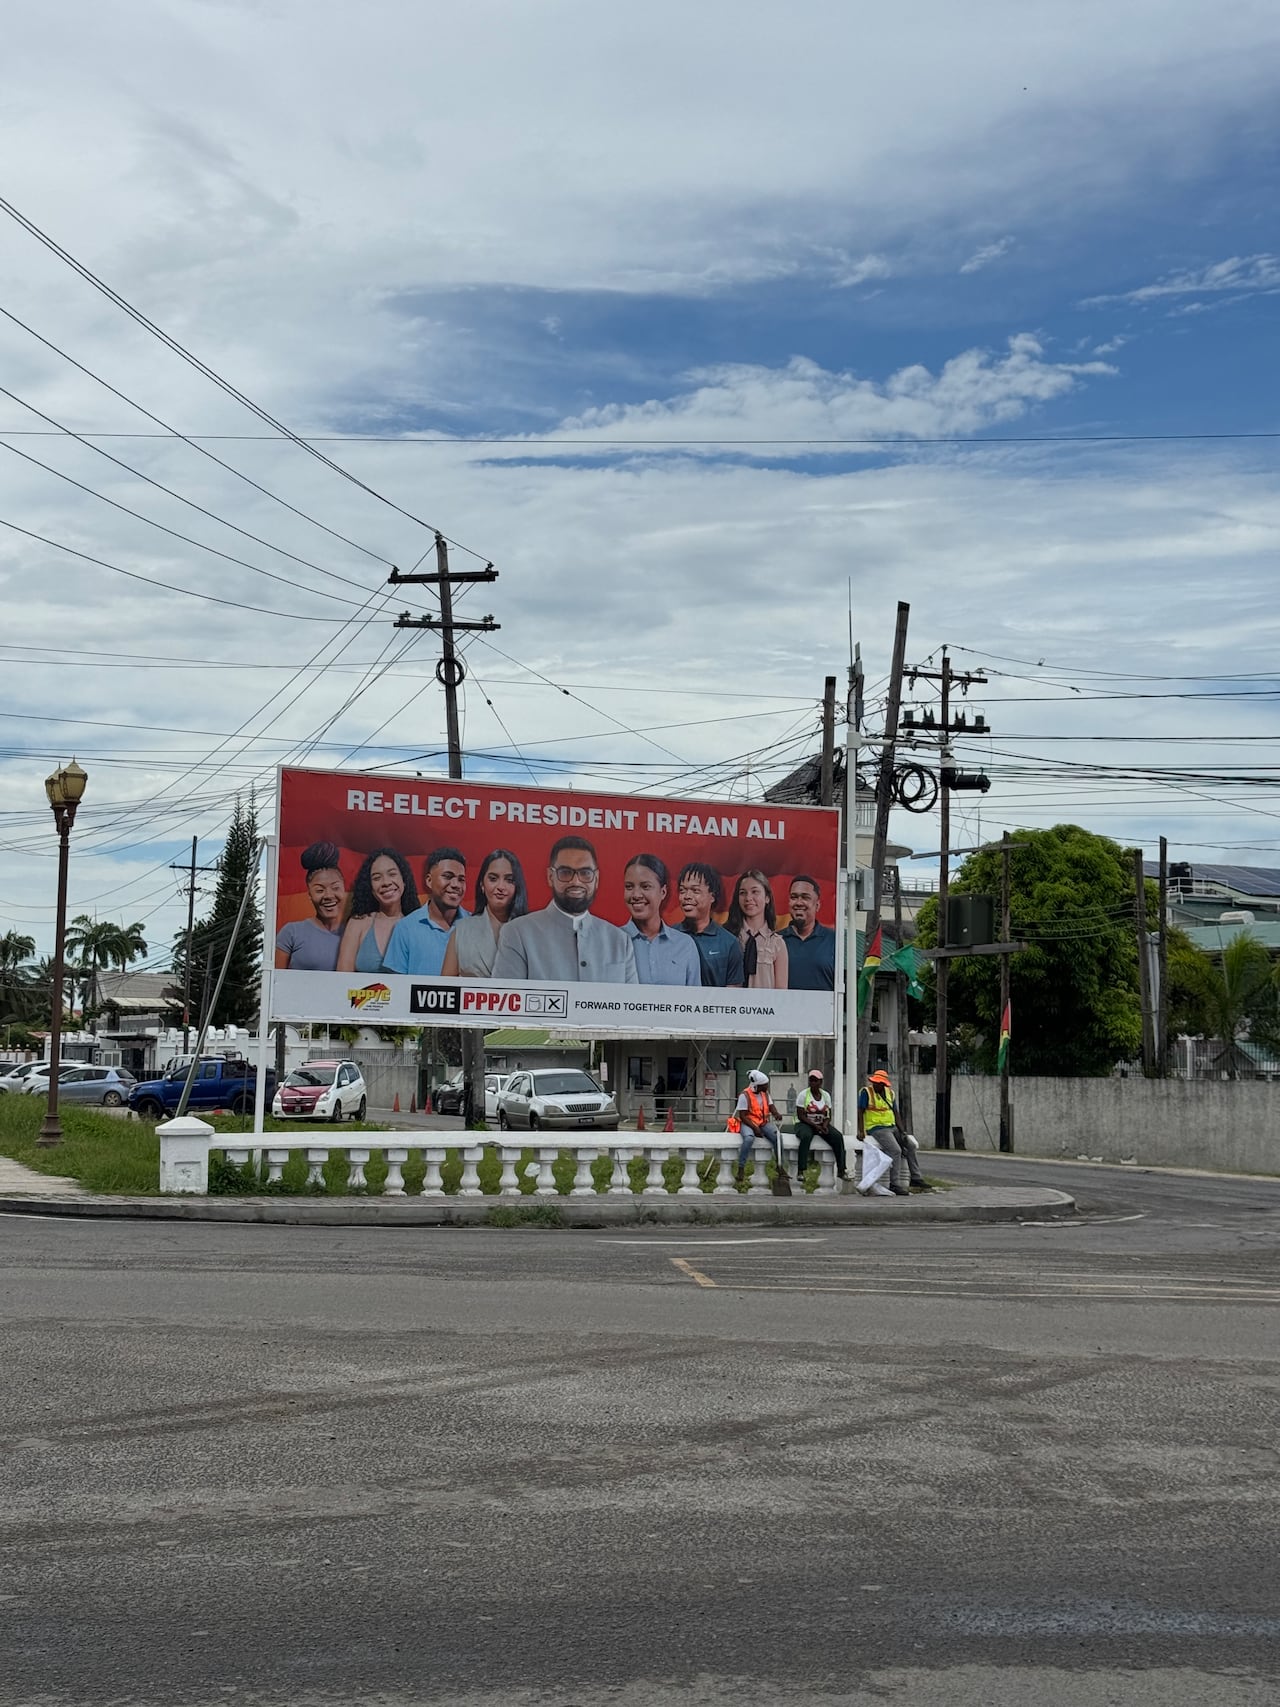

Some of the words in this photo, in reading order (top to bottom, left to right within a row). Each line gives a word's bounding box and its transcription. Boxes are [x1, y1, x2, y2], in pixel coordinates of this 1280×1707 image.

[347, 789, 481, 819] RE-ELECT
[489, 800, 639, 832] PRESIDENT
[647, 812, 738, 837] IRFAAN
[745, 818, 786, 840] ALI
[416, 990, 456, 1009] VOTE
[462, 992, 521, 1012] PPP/C
[574, 1000, 621, 1011] FORWARD
[623, 1002, 672, 1012] TOGETHER
[673, 1003, 693, 1013] FOR
[694, 1005, 702, 1014] A
[702, 1005, 737, 1015] BETTER
[739, 1006, 775, 1016] GUYANA
